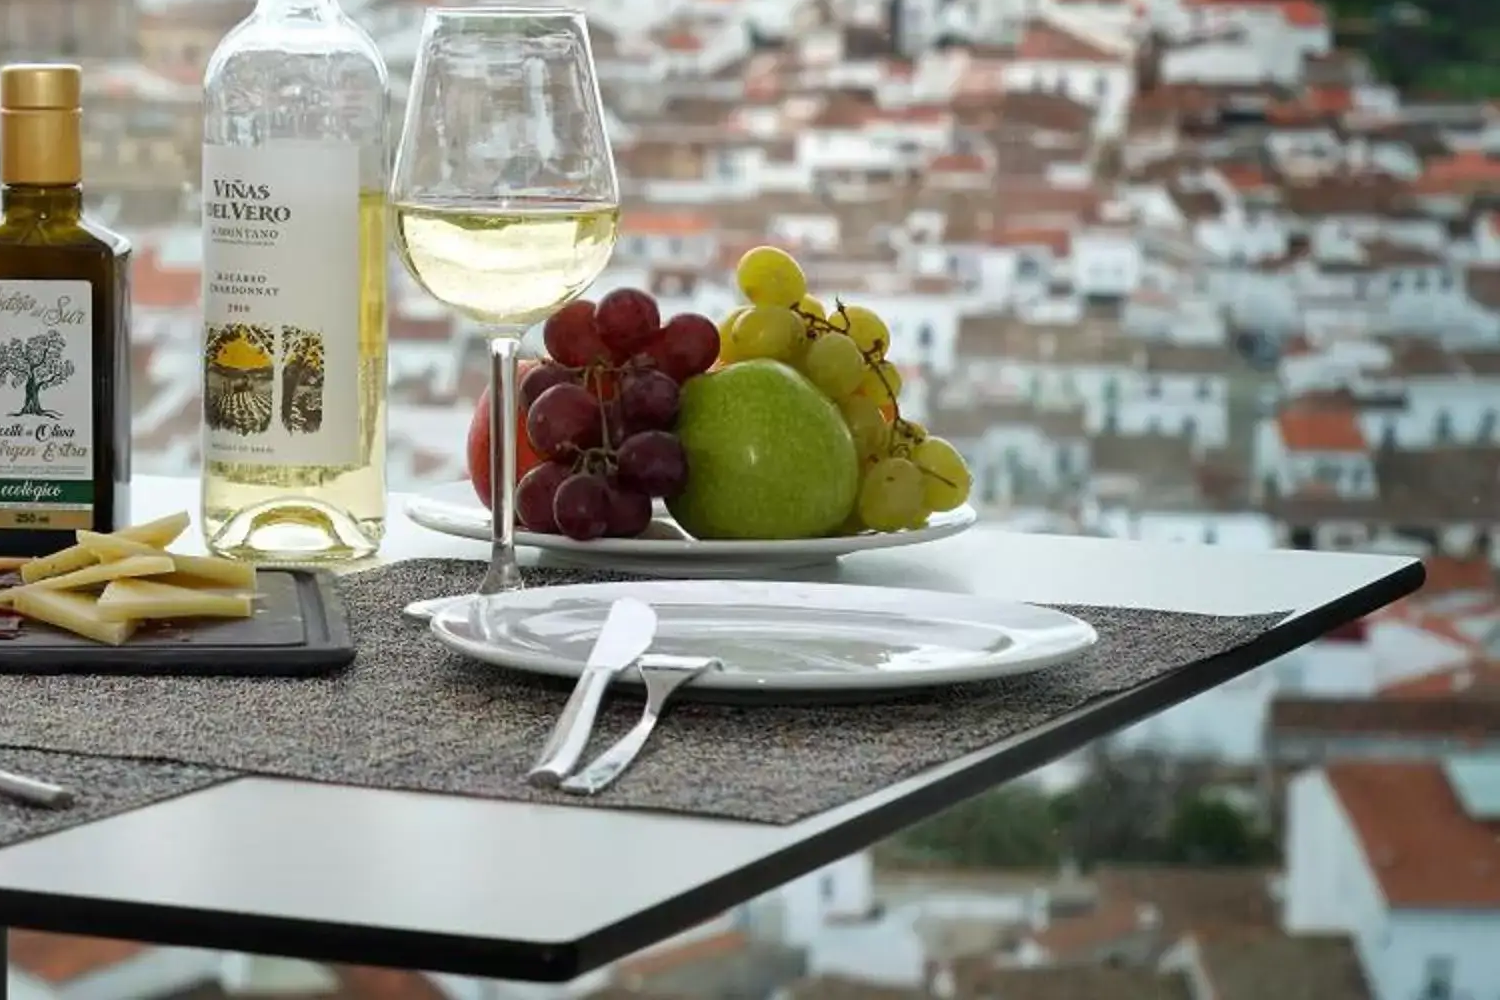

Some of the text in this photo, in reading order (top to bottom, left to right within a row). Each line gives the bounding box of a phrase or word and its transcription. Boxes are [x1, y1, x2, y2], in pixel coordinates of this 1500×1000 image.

[213, 179, 270, 200] VIÑAS
[42, 295, 84, 326] Sur
[41, 442, 88, 462] Extra
